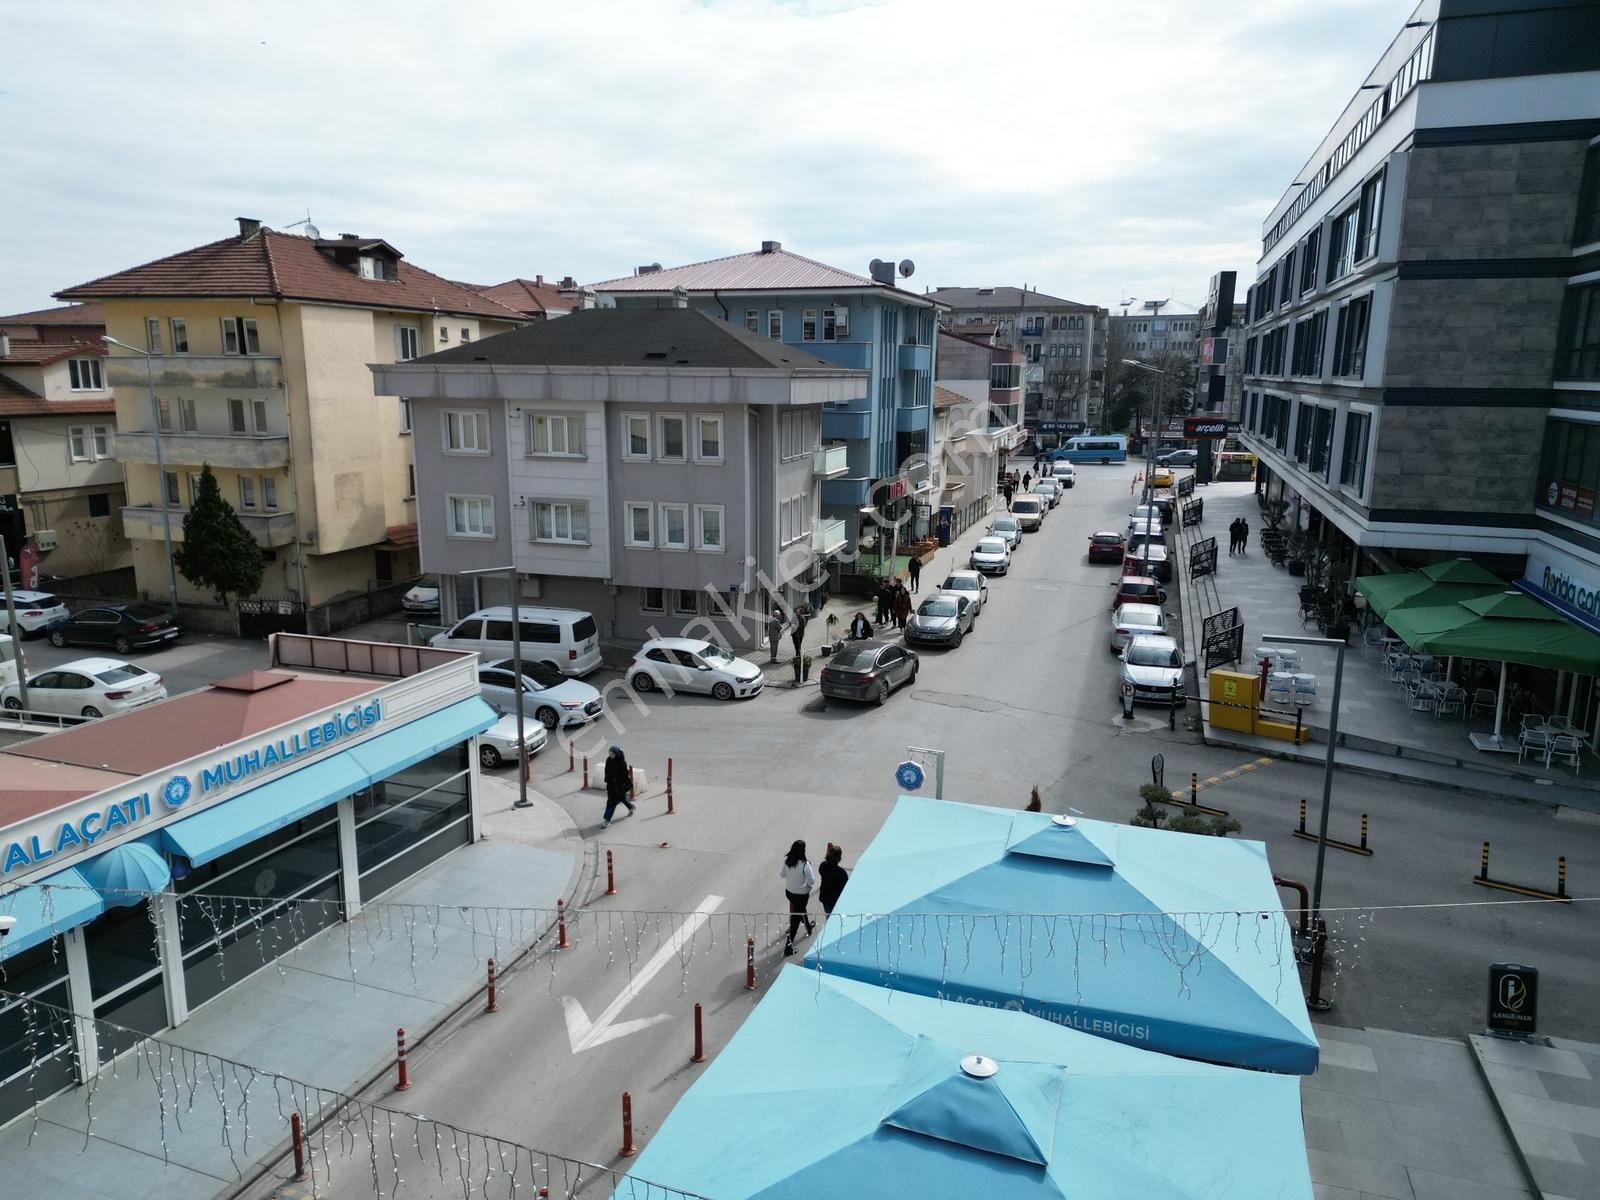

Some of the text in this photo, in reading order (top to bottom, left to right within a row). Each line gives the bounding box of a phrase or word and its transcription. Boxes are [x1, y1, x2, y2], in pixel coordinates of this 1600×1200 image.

[1195, 424, 1226, 434] arçelik
[4, 698, 382, 873] ALAÇATI MUHALLEBİCİSİ
[1028, 1008, 1150, 1040] MUHALLEBİCİSİ
